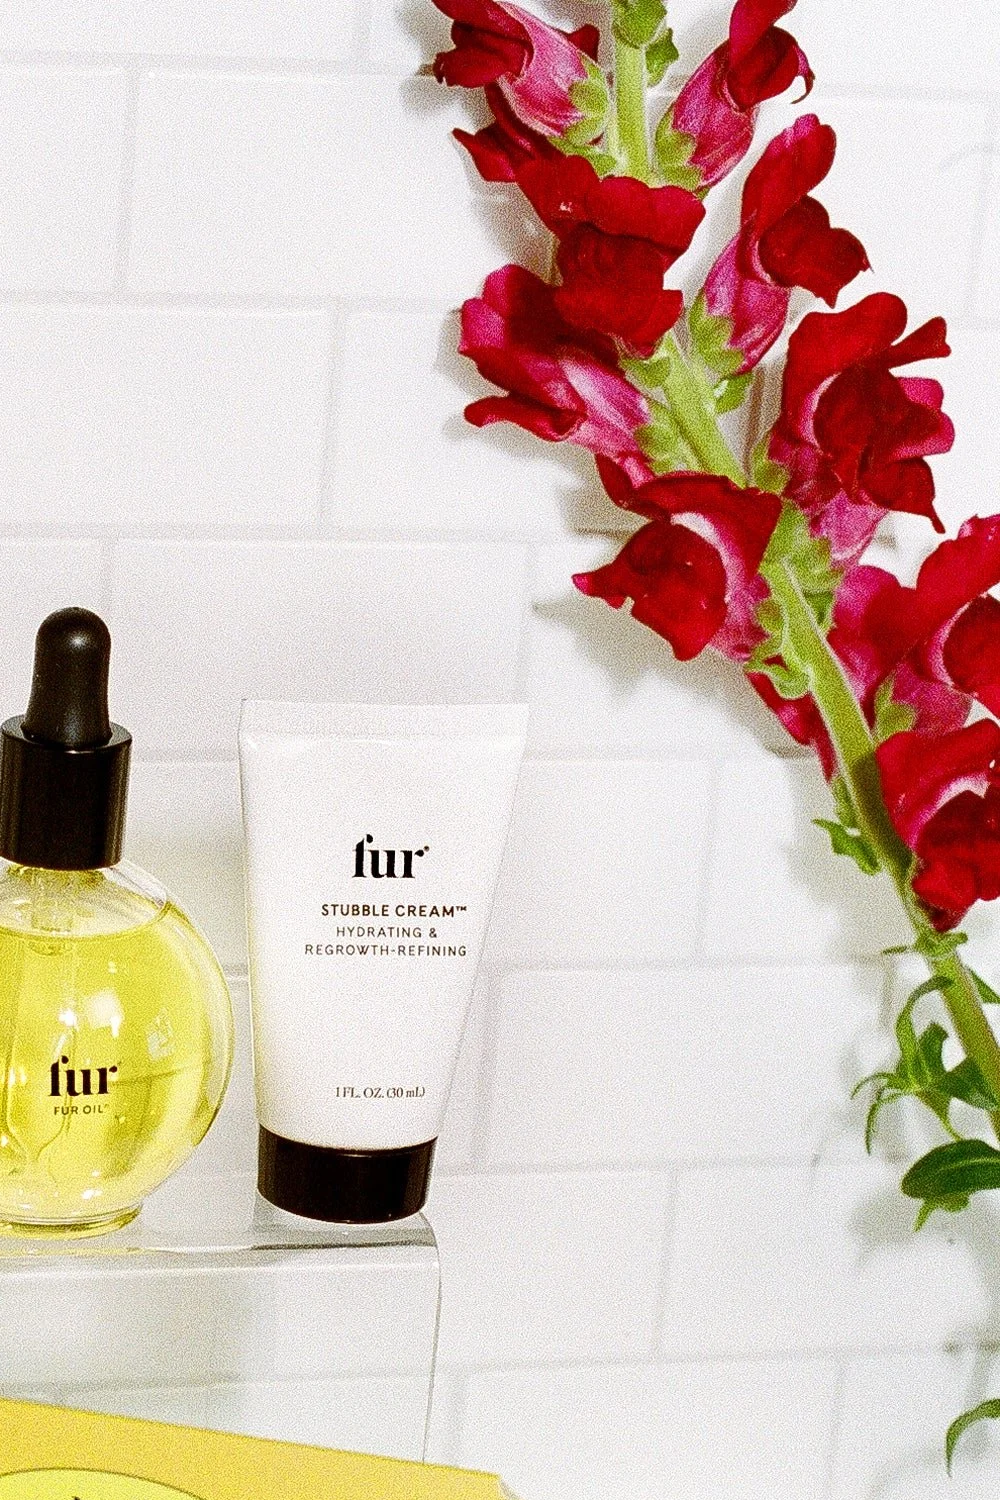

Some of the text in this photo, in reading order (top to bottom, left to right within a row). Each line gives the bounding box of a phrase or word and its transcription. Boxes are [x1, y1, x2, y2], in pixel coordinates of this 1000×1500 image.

[352, 833, 427, 878] fur
[321, 904, 389, 917] STUBBLE
[336, 926, 437, 938] HYDRATING &
[305, 944, 467, 957] REGROWTH-REFINING
[48, 1055, 118, 1097] fur
[363, 1087, 384, 1099] OZ.
[386, 1086, 404, 1099] (30
[54, 1105, 78, 1116] FUR
